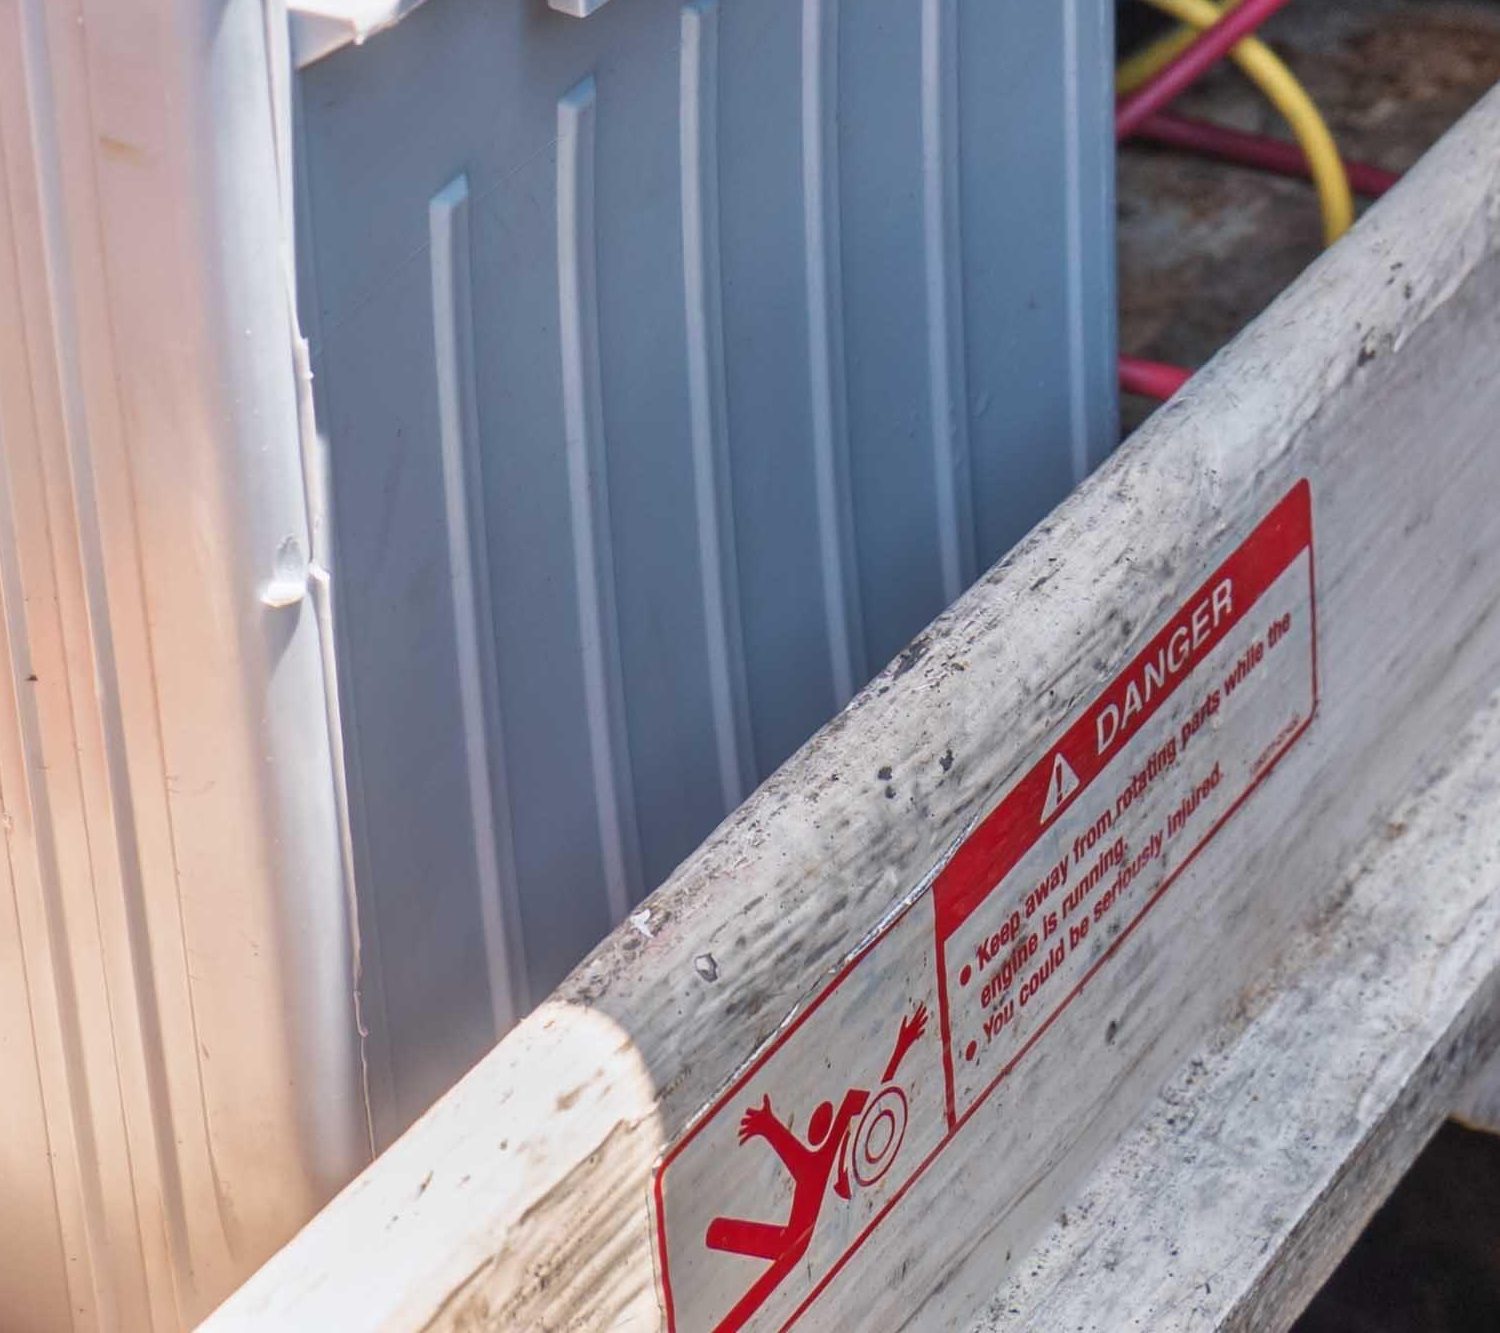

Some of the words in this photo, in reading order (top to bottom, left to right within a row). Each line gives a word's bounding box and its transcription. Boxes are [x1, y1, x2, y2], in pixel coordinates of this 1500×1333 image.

[1094, 577, 1234, 756] DANGER
[975, 910, 1022, 971] Keep
[1024, 858, 1070, 920] away
[1072, 809, 1113, 864] from
[1114, 732, 1178, 823] rotating
[1180, 688, 1221, 752] parts
[1223, 640, 1265, 697] while
[1268, 611, 1292, 650] the
[982, 999, 1015, 1045] You
[1018, 943, 1065, 1008] could
[1068, 918, 1090, 952] be
[1093, 832, 1164, 923] seriously
[1166, 759, 1225, 839] injured.
[980, 935, 1039, 1010] engine
[1041, 908, 1058, 941] is
[1061, 837, 1130, 921] running.
